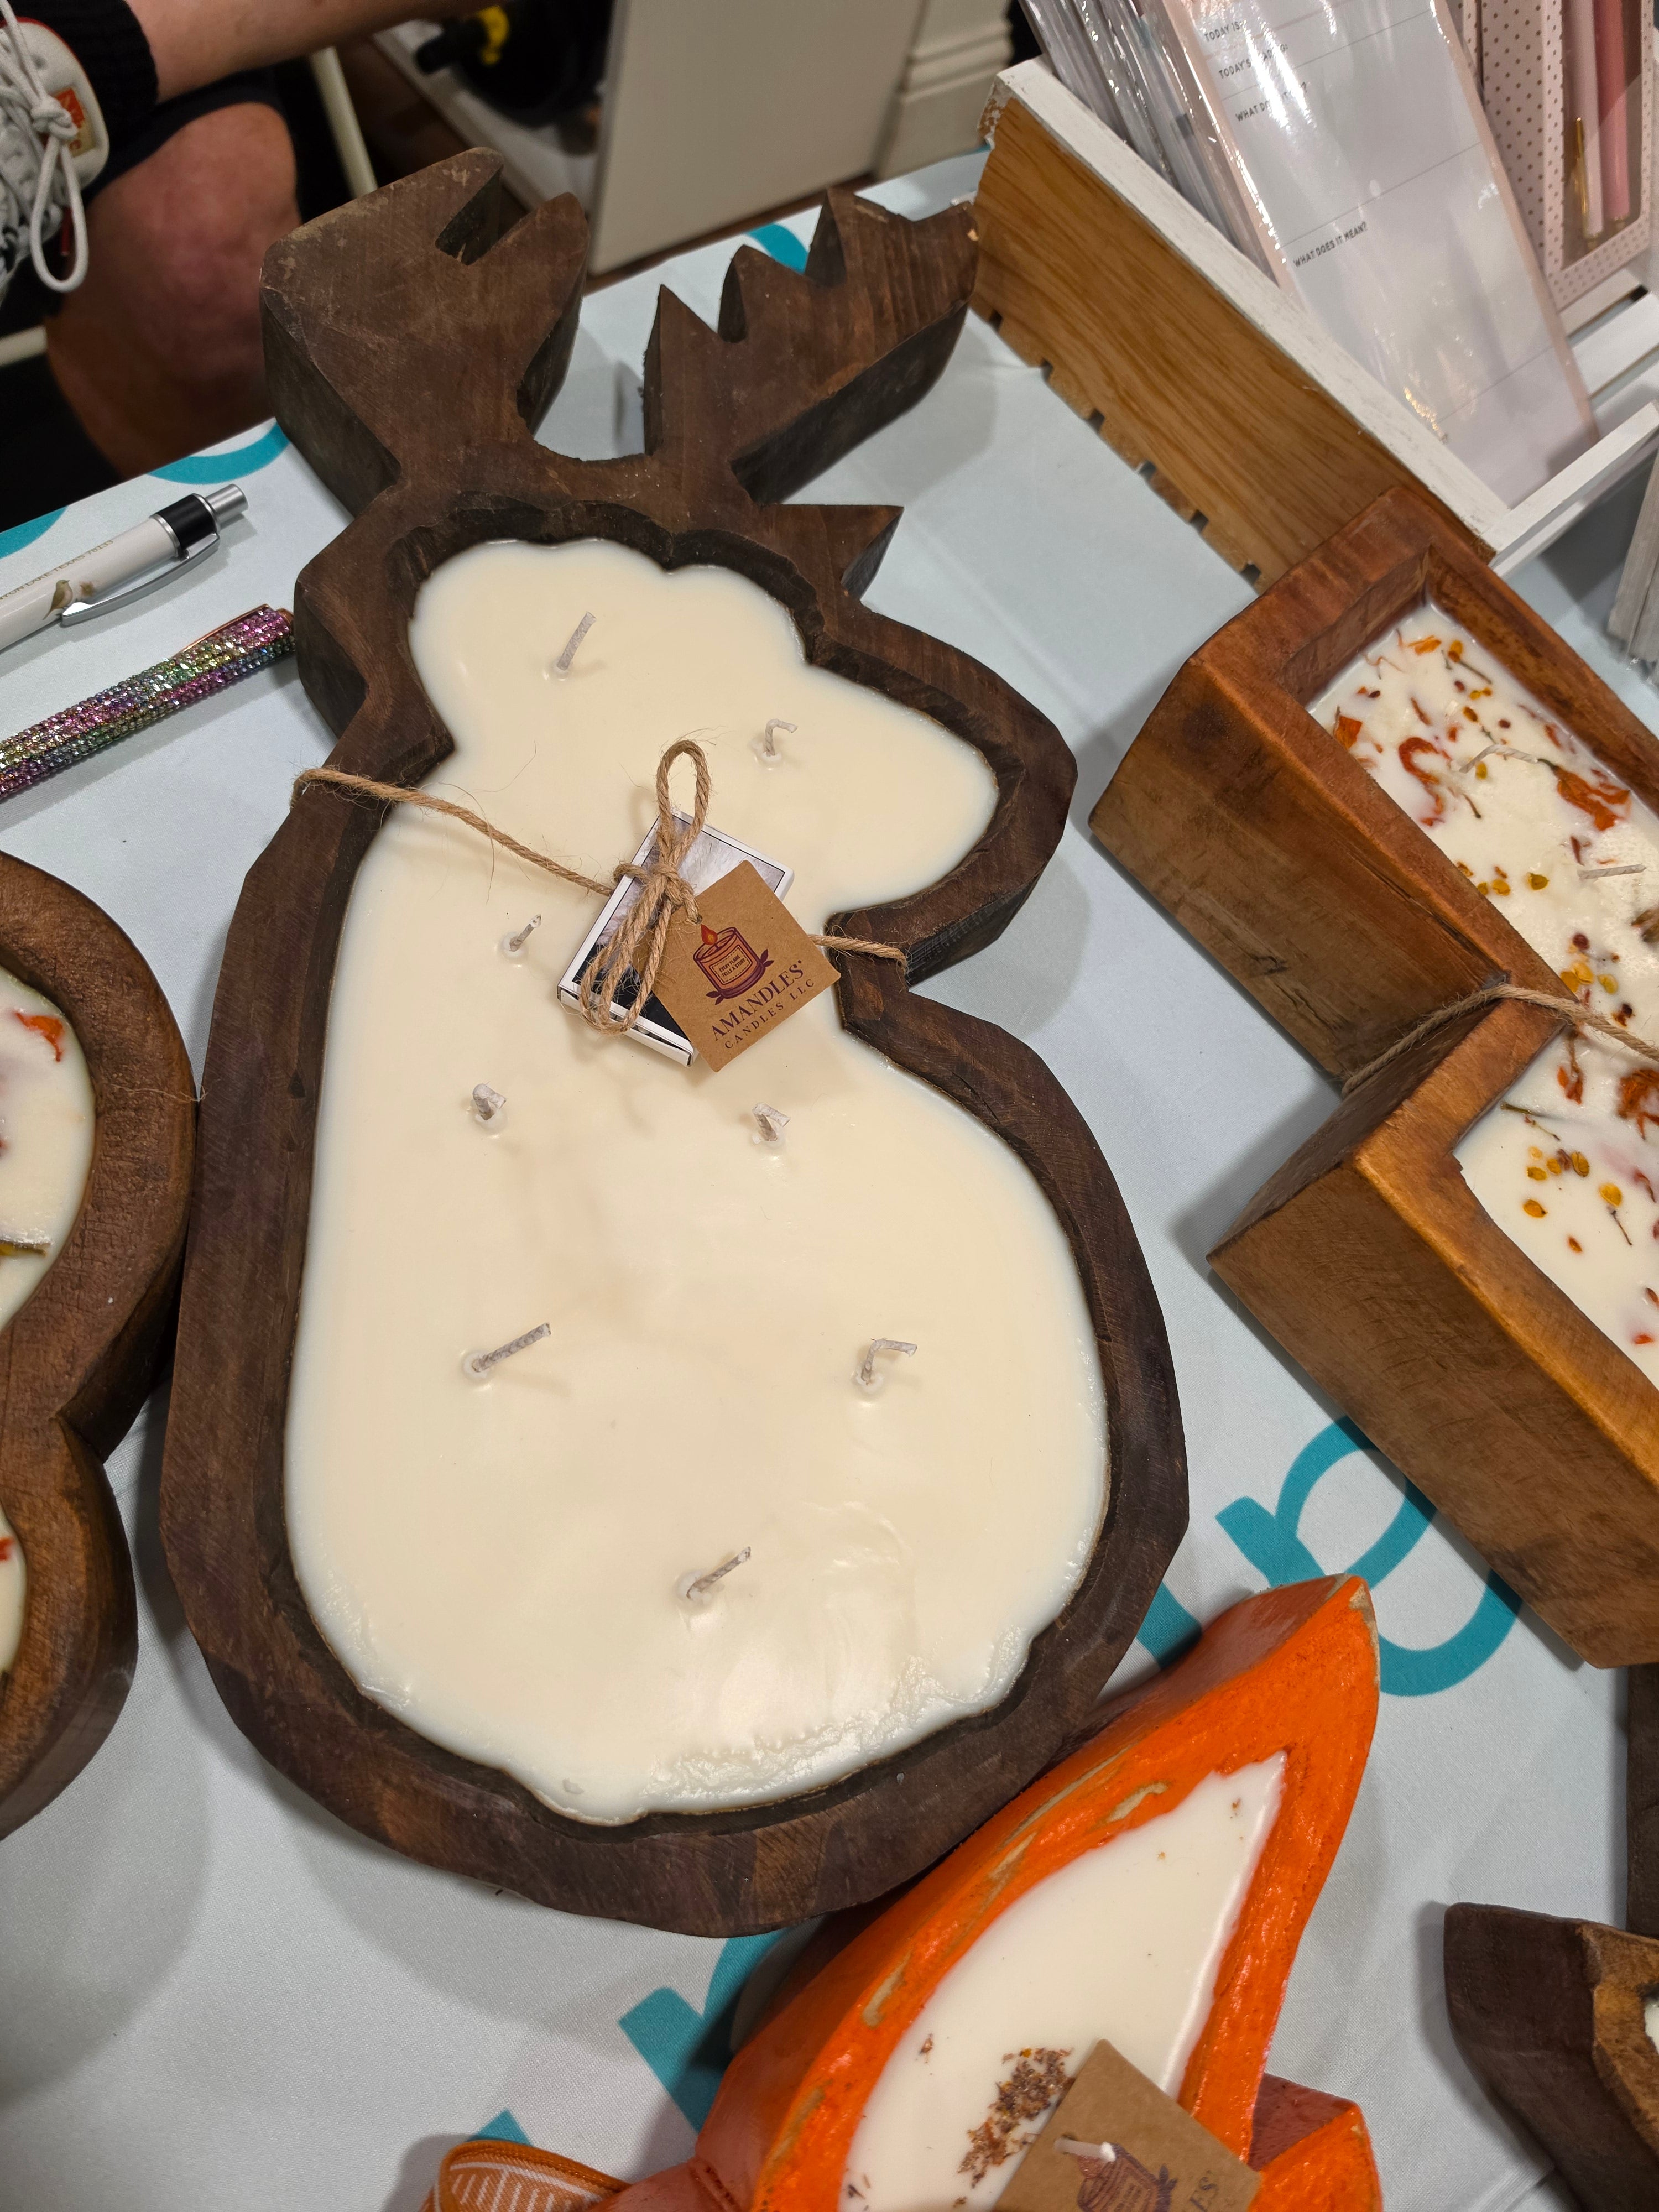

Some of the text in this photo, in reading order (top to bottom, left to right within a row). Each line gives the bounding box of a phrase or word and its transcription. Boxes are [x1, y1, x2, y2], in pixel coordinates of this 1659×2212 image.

[1204, 24, 1229, 42] TODAY
[1219, 58, 1251, 79] TODAY'S
[1235, 104, 1258, 121] WHAT
[1293, 221, 1367, 267] WHAT DOES IT MEAN?
[25, 572, 53, 586] LAKE
[54, 555, 85, 571] TEXAS
[719, 954, 740, 972] EVERY FLAME
[722, 968, 732, 977] TELLS
[734, 958, 745, 968] STORY
[712, 960, 804, 1041] AMANDLES'
[724, 979, 814, 1048] CANDLES LLC
